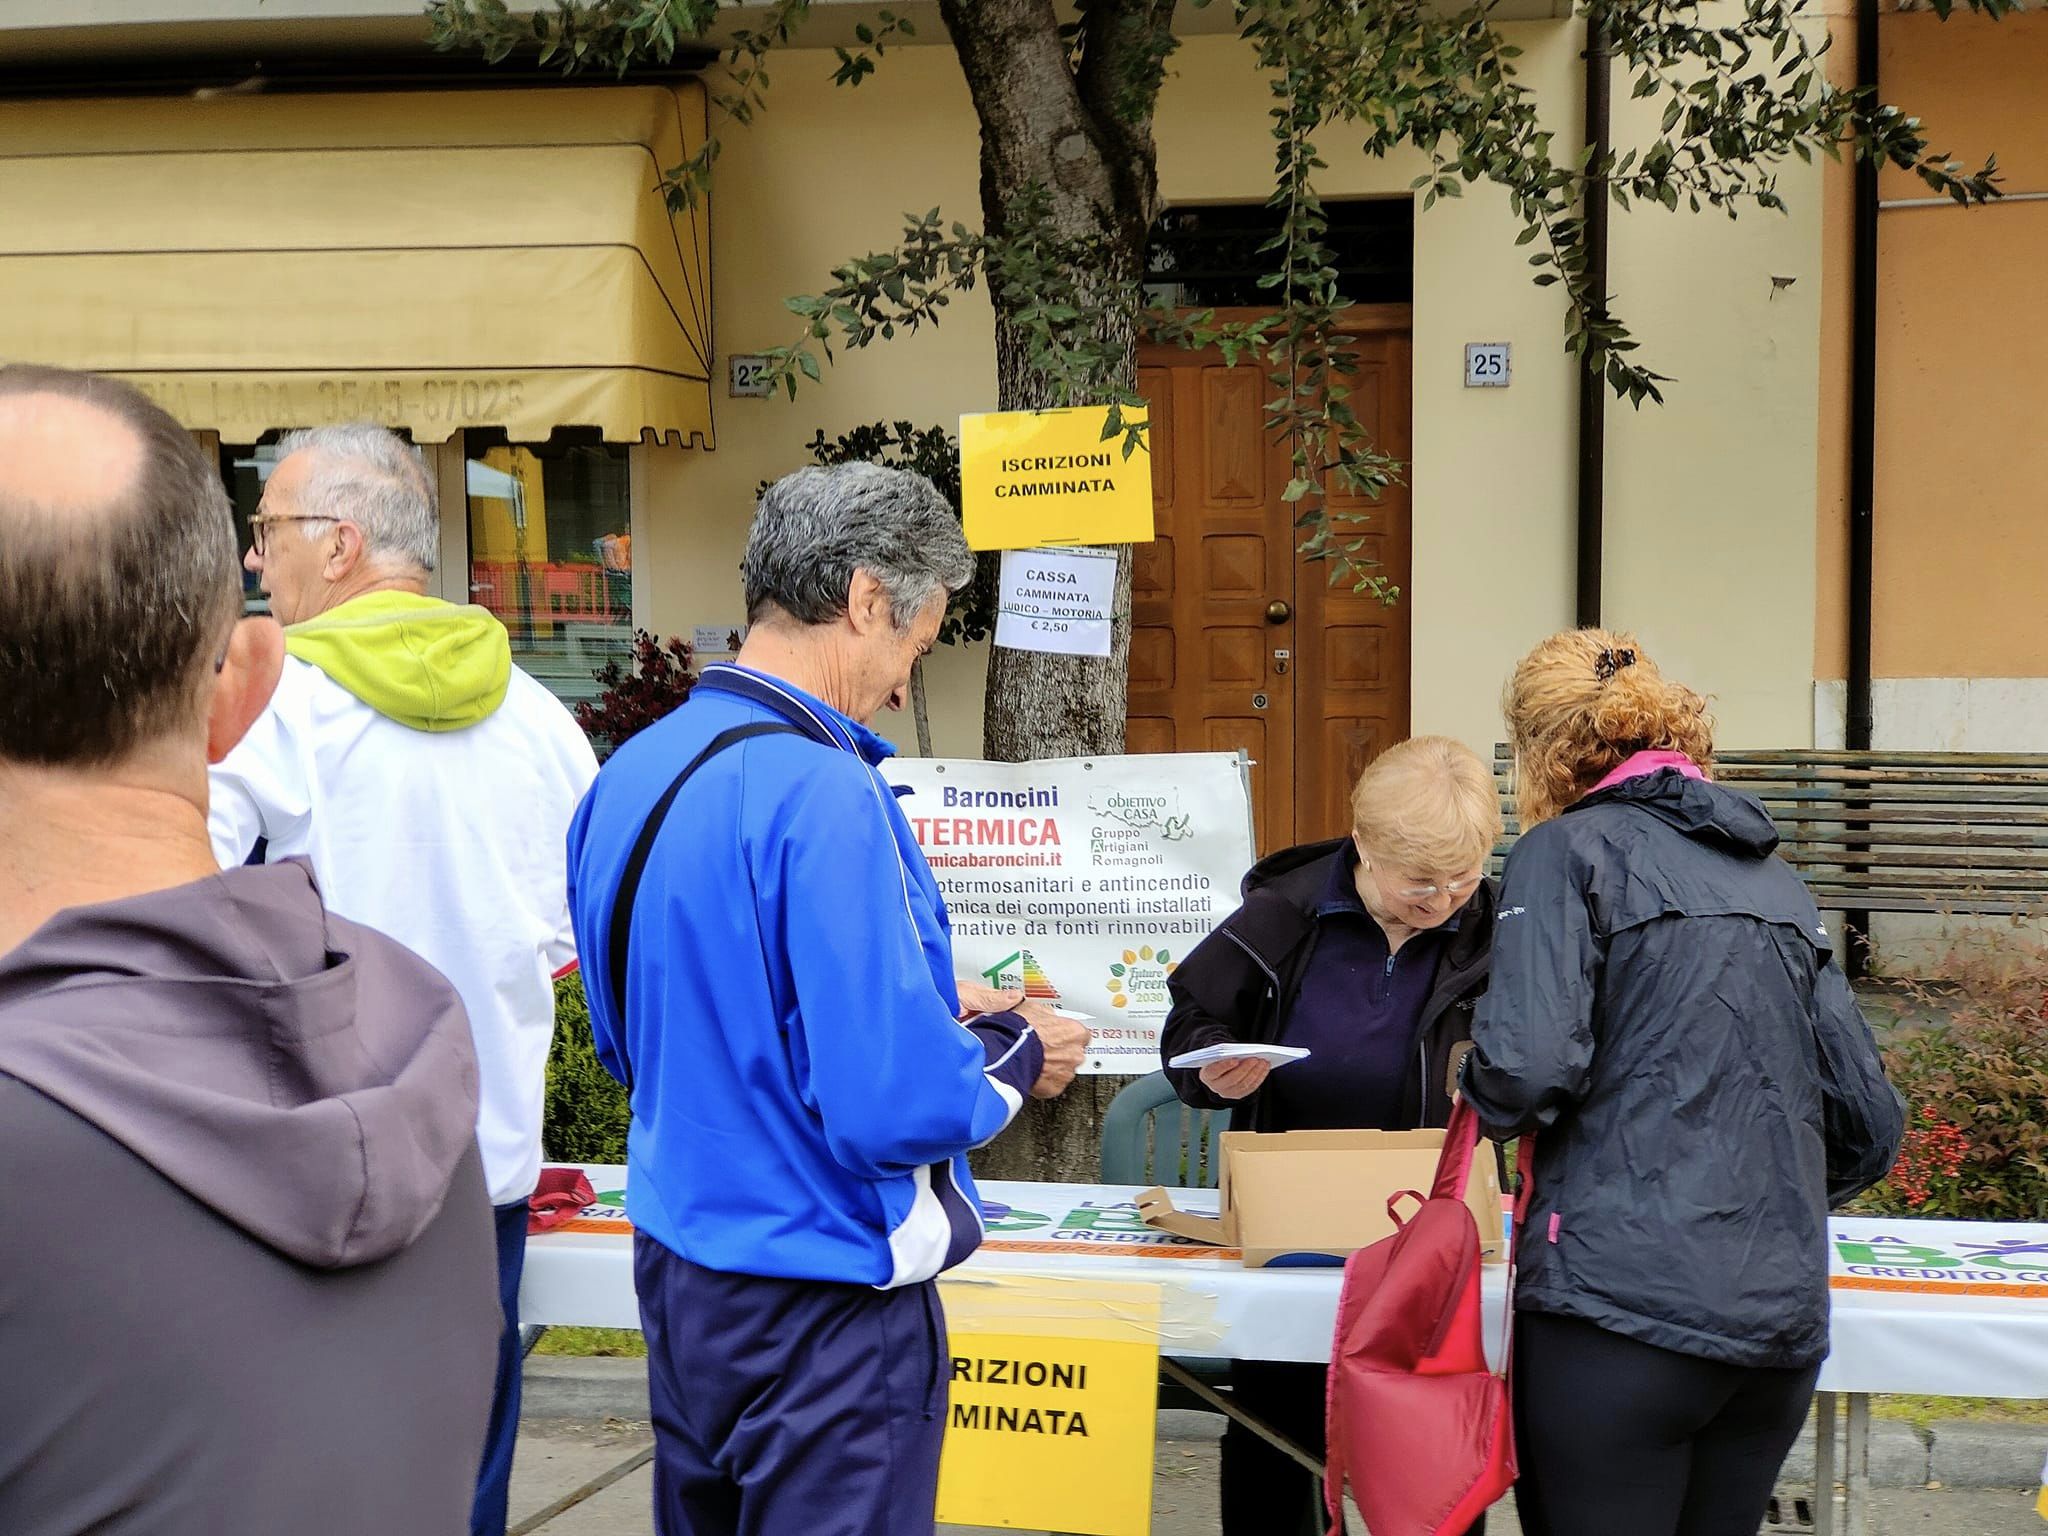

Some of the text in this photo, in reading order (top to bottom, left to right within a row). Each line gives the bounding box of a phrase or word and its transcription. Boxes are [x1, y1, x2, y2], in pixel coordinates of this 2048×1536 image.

[1474, 354, 1502, 375] 25
[1002, 453, 1112, 473] ISCRIZIONI
[995, 479, 1116, 498] CAMMINATA
[1025, 569, 1078, 585] CASSA
[1015, 587, 1090, 603] CAMMINATA
[1003, 602, 1040, 615] LUDICO
[1052, 607, 1103, 620] MOTORIA
[1031, 621, 1068, 633] € 2,50
[943, 785, 1059, 809] Baroncini
[1123, 808, 1158, 820] CASA
[912, 817, 1061, 847] TERMICA
[1091, 826, 1141, 841] Gruppo
[1091, 839, 1149, 854] Artigiani
[1092, 854, 1164, 868] Romagnoli
[1082, 881, 1092, 892] e
[1100, 874, 1211, 892] antincendio
[996, 899, 1022, 915] dei
[1027, 900, 1131, 919] componenti
[1136, 896, 1212, 914] installati
[1024, 919, 1048, 936] da
[1056, 918, 1100, 936] fonti
[1108, 916, 1212, 935] rinnovabili
[1128, 977, 1166, 993] Green
[1136, 993, 1164, 1003] 2030
[1102, 1028, 1122, 1039] 623
[1125, 1029, 1138, 1039] 11
[1142, 1030, 1156, 1040] 19
[1050, 1230, 1193, 1245] CREDITO
[1836, 1234, 1912, 1244] LA
[1847, 1265, 2008, 1281] CREDITO
[951, 1357, 1088, 1390] RIZIONI
[953, 1404, 1089, 1437] MINATA
